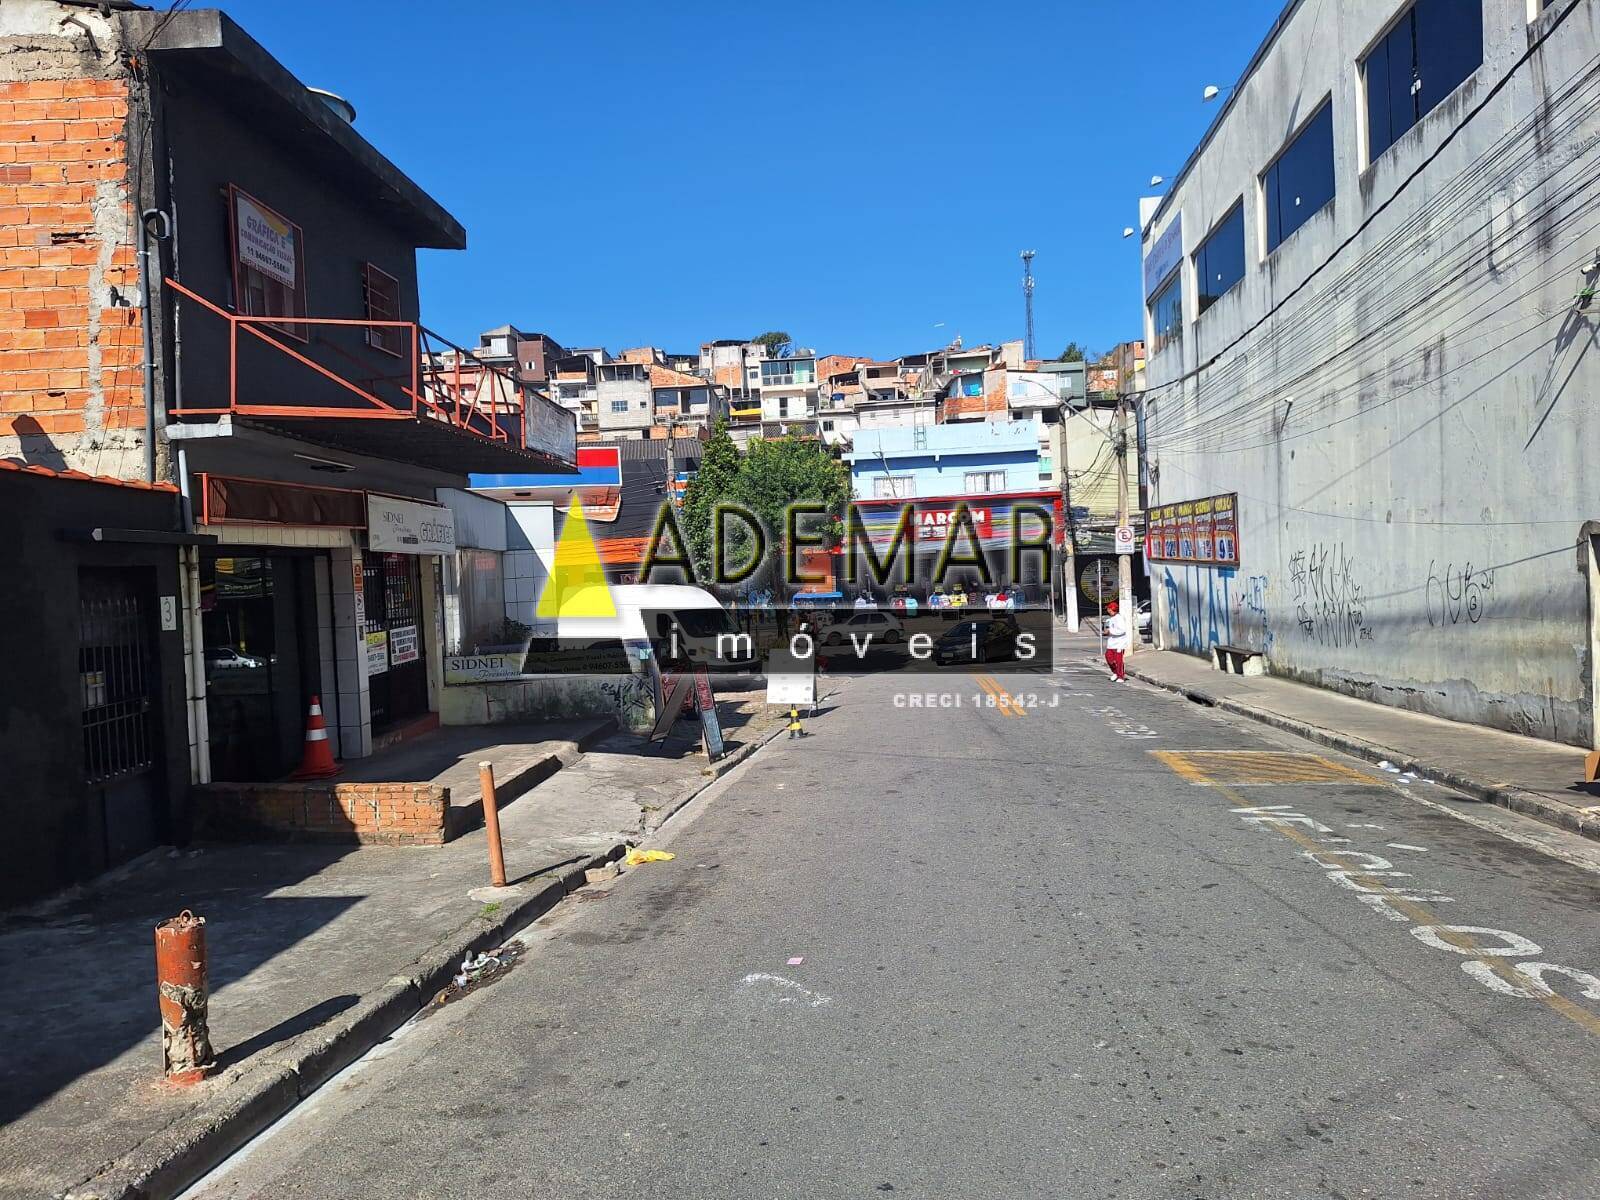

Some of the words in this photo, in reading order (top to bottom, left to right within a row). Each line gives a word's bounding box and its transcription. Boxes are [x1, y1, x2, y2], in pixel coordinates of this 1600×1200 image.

[247, 214, 280, 246] GRÁFICA
[420, 517, 455, 545] GRÁFICA
[451, 657, 504, 671] SIDNEI
